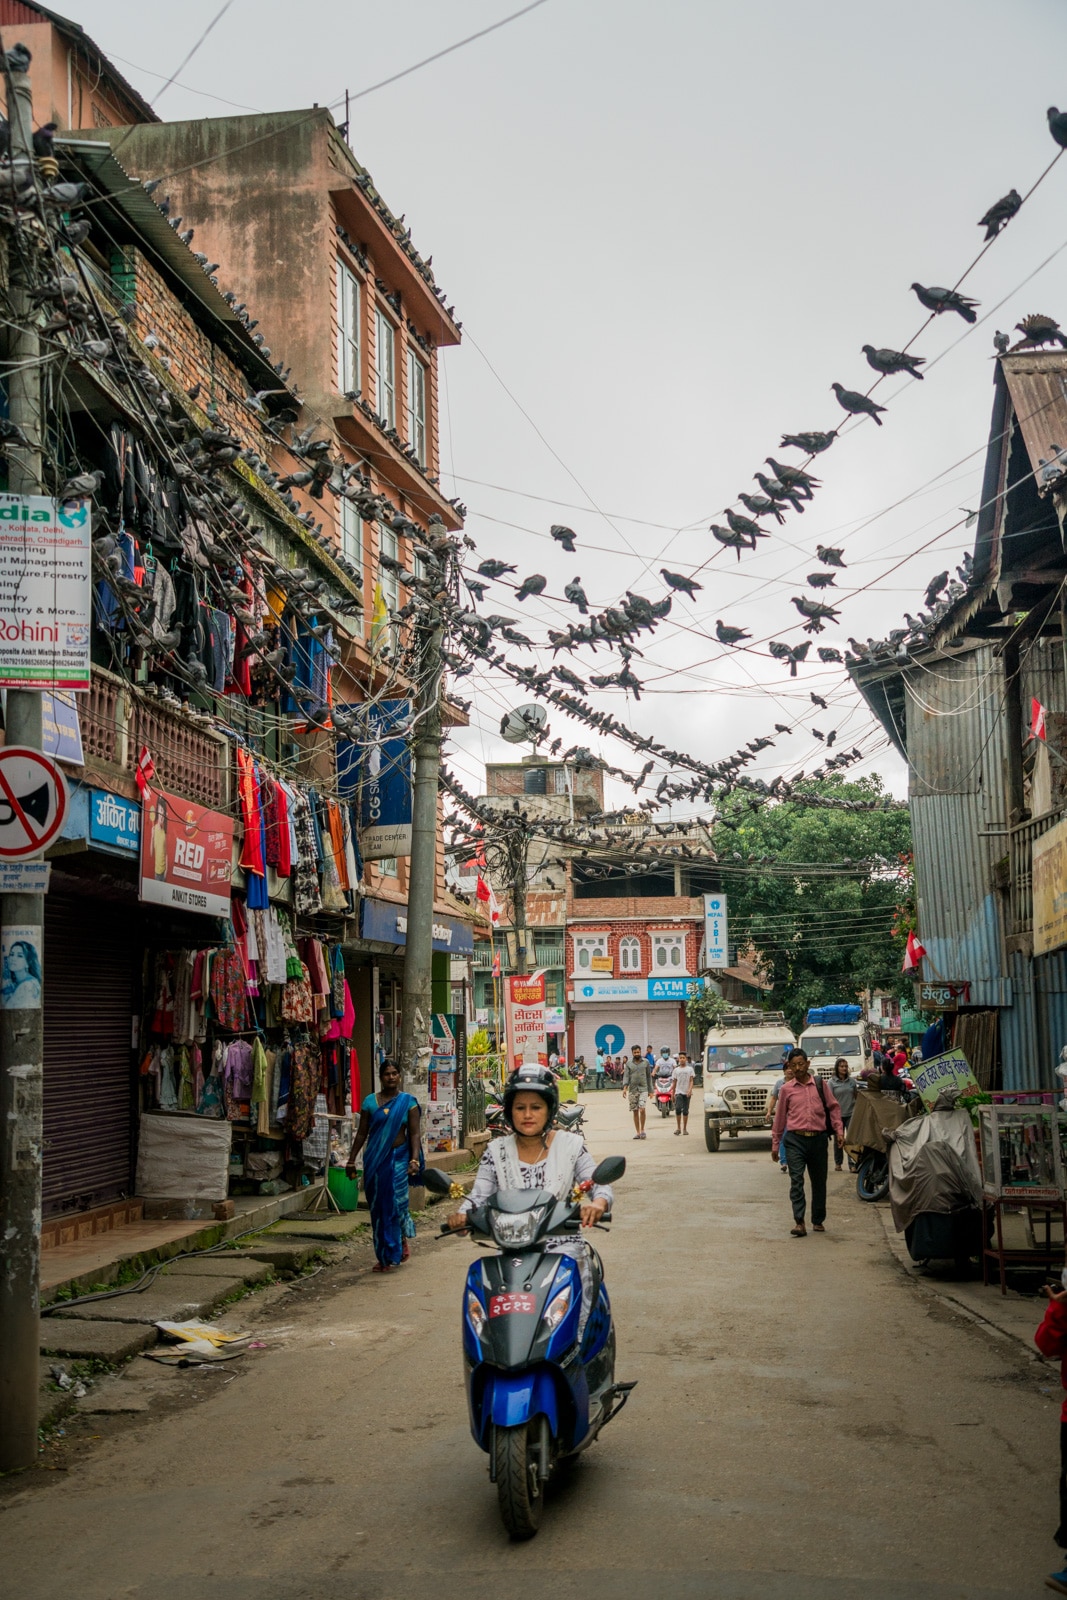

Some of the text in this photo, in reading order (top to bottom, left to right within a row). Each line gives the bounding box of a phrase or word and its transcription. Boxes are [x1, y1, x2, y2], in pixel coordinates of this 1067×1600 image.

[9, 524, 41, 533] Kolkata,
[37, 536, 83, 547] Chandigarh
[11, 557, 84, 567] Management
[48, 607, 86, 616] More...
[21, 648, 36, 656] Ankit
[97, 794, 126, 832] अंकित
[369, 798, 381, 819] CG
[175, 837, 205, 870] RED
[172, 889, 207, 908] ANKIT STORES
[653, 981, 683, 991] ATM
